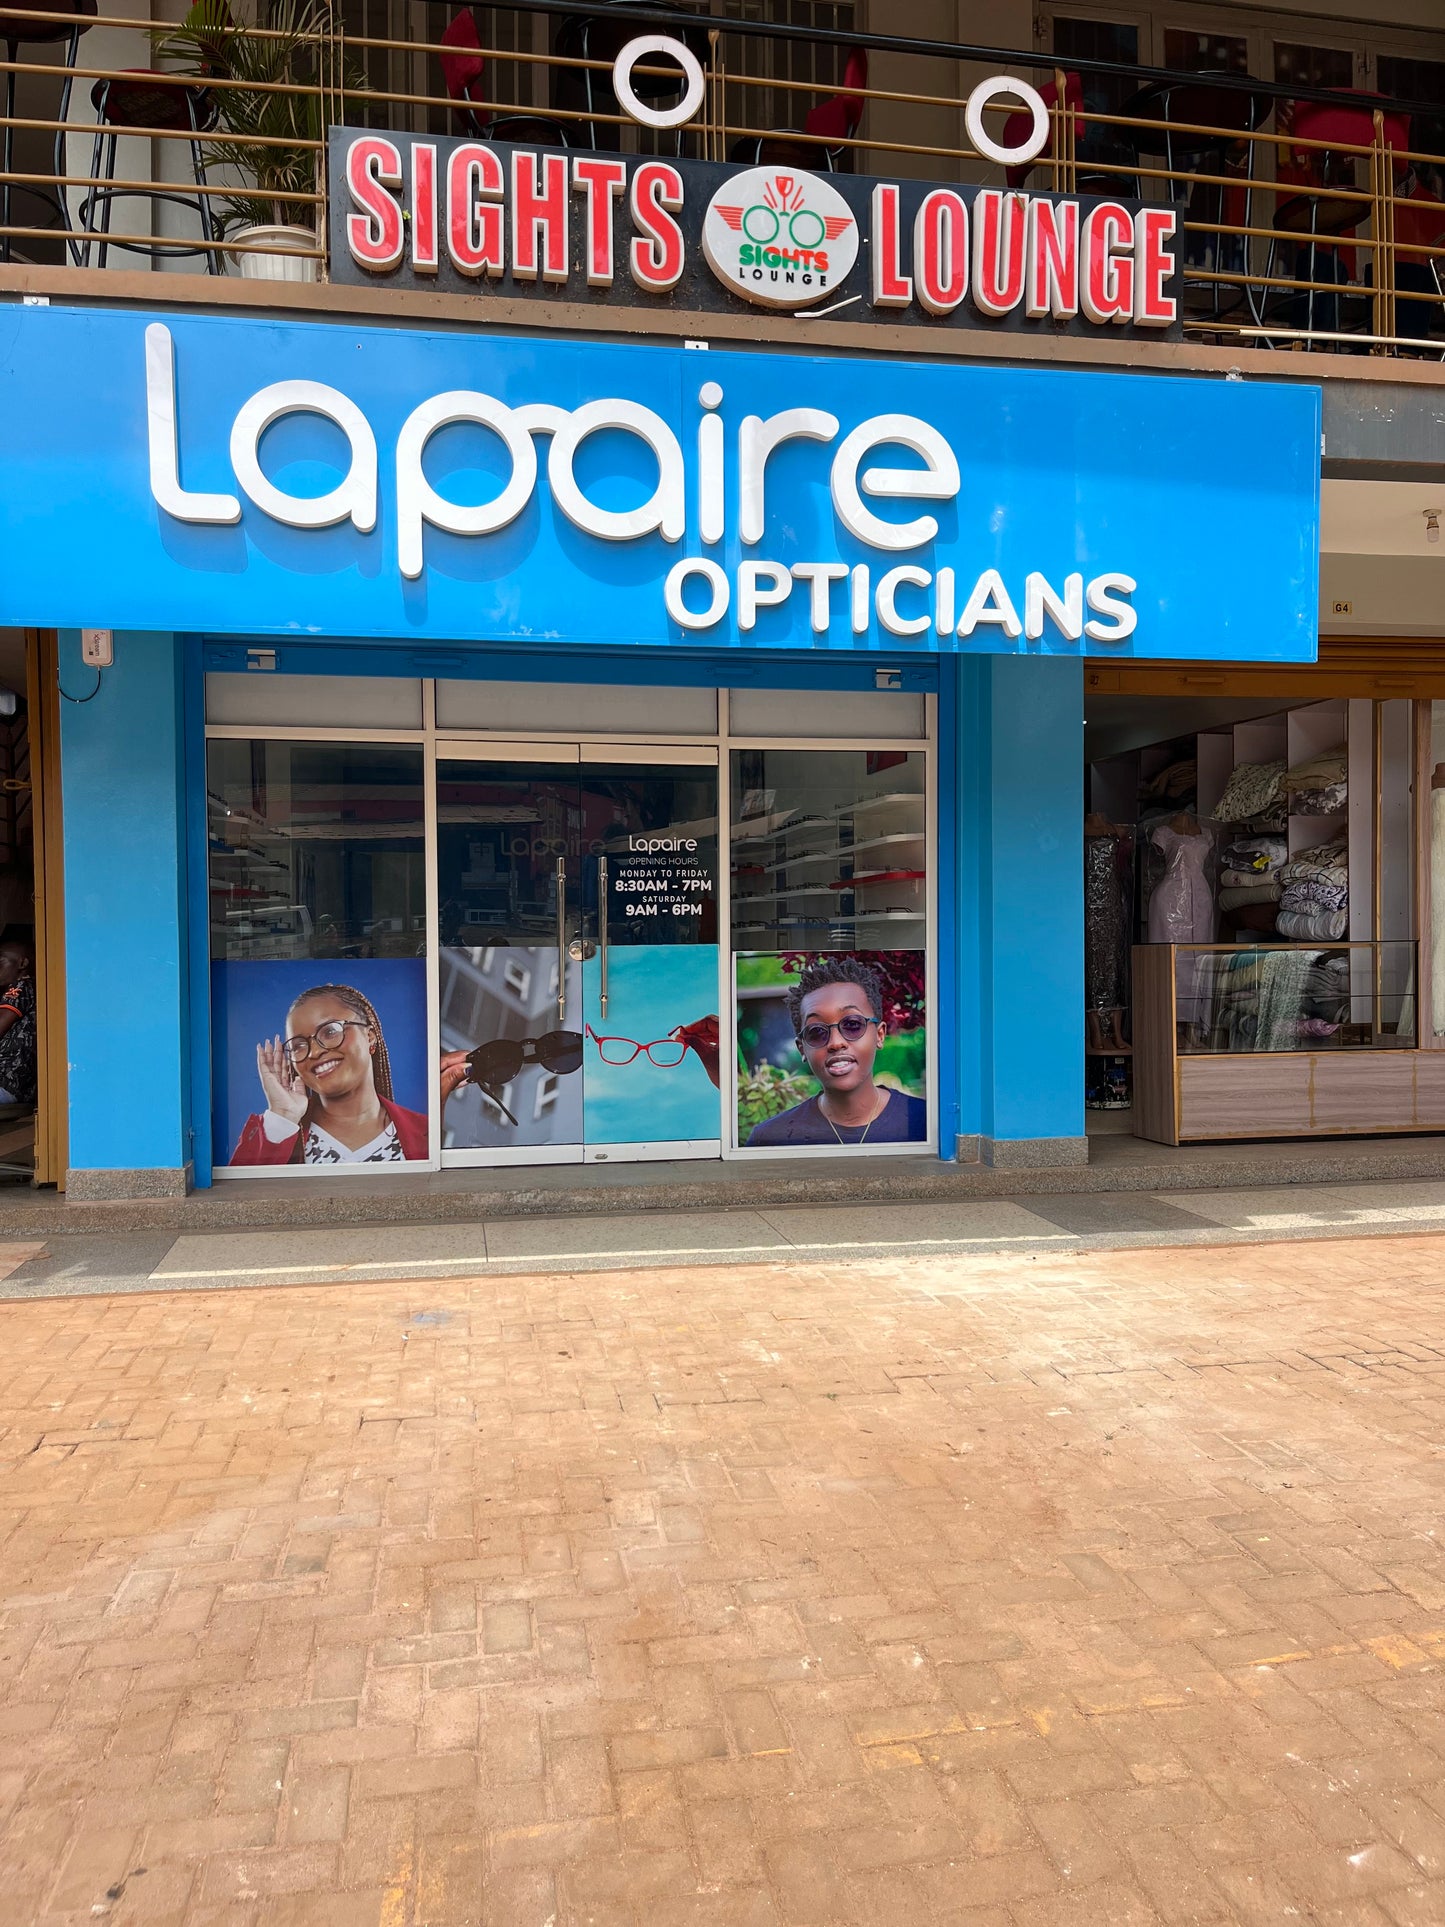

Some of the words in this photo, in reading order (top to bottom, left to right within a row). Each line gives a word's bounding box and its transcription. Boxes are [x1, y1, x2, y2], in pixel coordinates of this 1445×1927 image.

[346, 136, 685, 291] SIGHTS
[873, 183, 1177, 326] LOUNGE
[739, 244, 829, 273] SIGHTS
[739, 267, 827, 287] LOUNGE
[145, 322, 961, 579] Lapaire
[664, 557, 1138, 642] OPTICIANS
[1335, 603, 1349, 613] G4
[629, 835, 698, 855] Lapaire
[628, 857, 667, 866] OPENING
[668, 857, 699, 866] HOURS
[619, 869, 657, 878] MONDAY
[661, 869, 673, 878] TO
[676, 869, 708, 878] FRIDAY
[615, 880, 668, 892] 8:30AM
[682, 880, 712, 892] 7PM
[642, 895, 687, 903] SATURDAY
[625, 904, 658, 916] 9AM
[671, 904, 703, 916] 6PM
